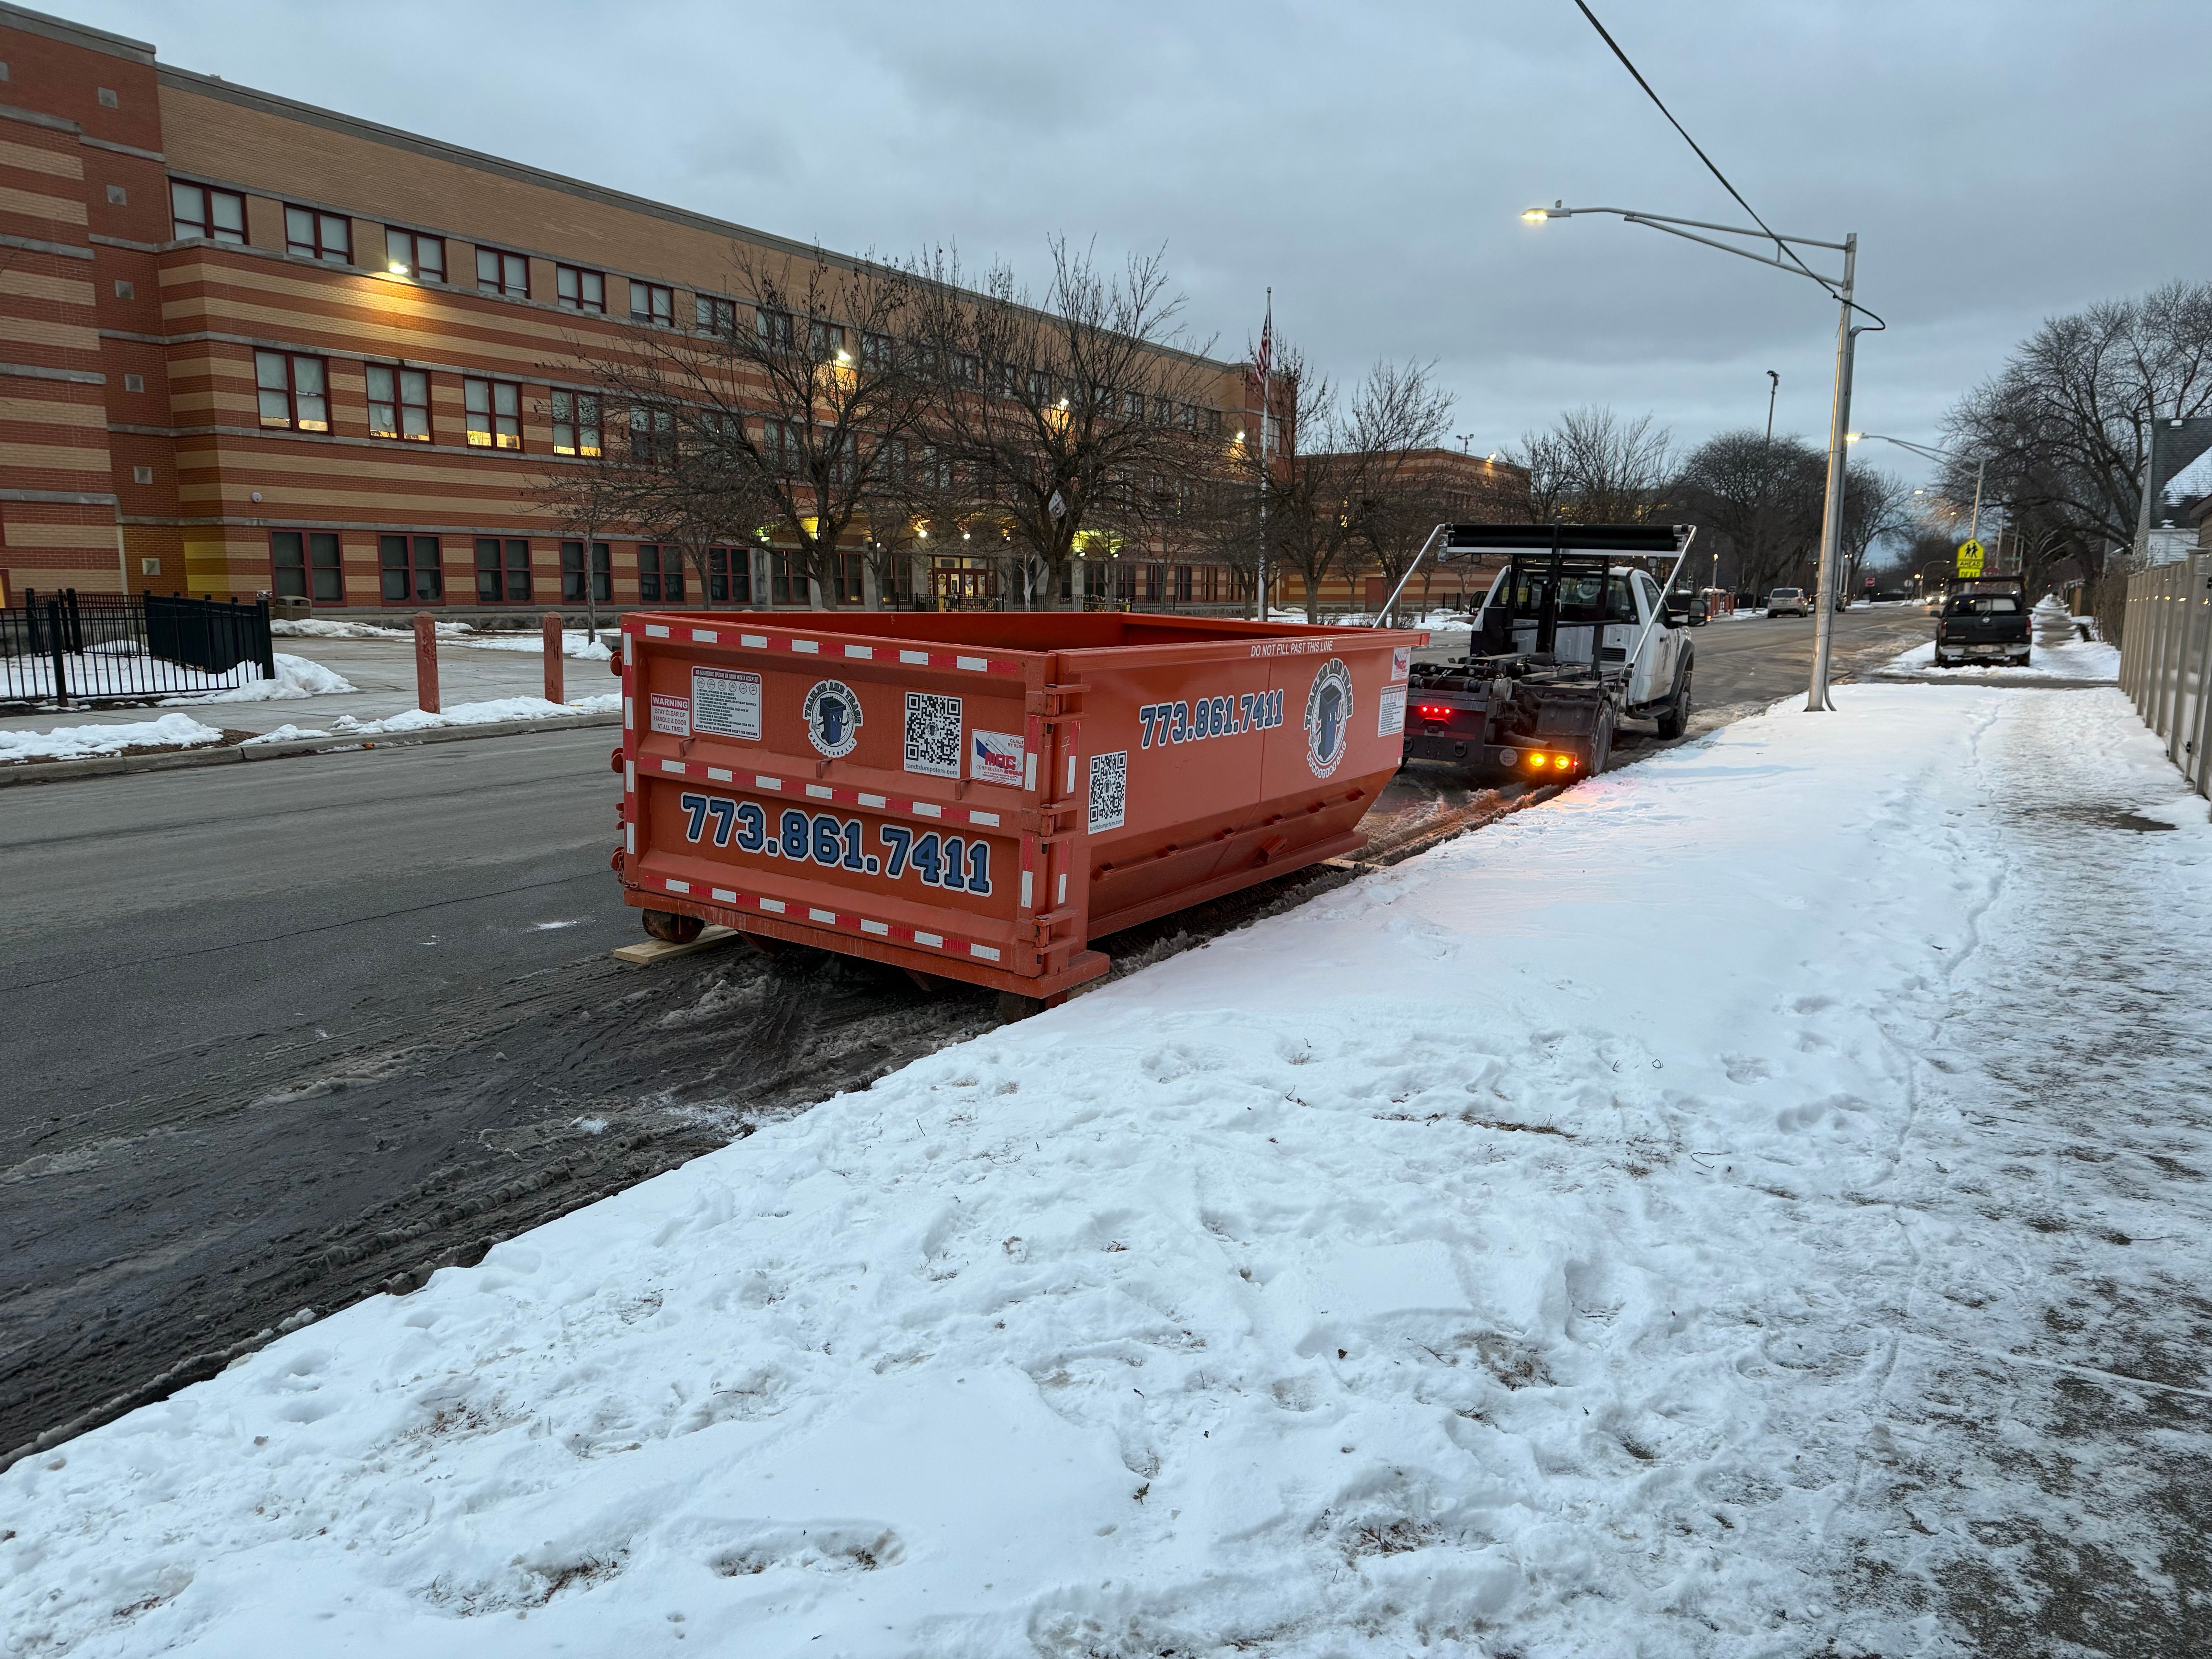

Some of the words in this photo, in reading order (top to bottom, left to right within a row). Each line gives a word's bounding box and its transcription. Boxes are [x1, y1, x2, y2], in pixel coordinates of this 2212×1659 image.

[1251, 645, 1261, 657] DO
[1262, 644, 1276, 656] NOT
[1277, 644, 1289, 654] FILL
[1290, 642, 1306, 654] PAST
[1307, 641, 1319, 653] THIS
[1320, 641, 1333, 651] LINE
[653, 697, 688, 708] WARNING
[805, 683, 828, 717] TRAILER
[829, 682, 845, 694] AND
[845, 690, 861, 724] TRASH
[1140, 689, 1283, 750] 773.861.7411
[810, 734, 844, 755] DUMPSTERS
[846, 740, 855, 751] LLC
[906, 763, 958, 775] tandtdumpsters.com
[976, 765, 1003, 773] CORPORATION
[985, 752, 1016, 770] MAC
[681, 792, 992, 897] 773.861.7411
